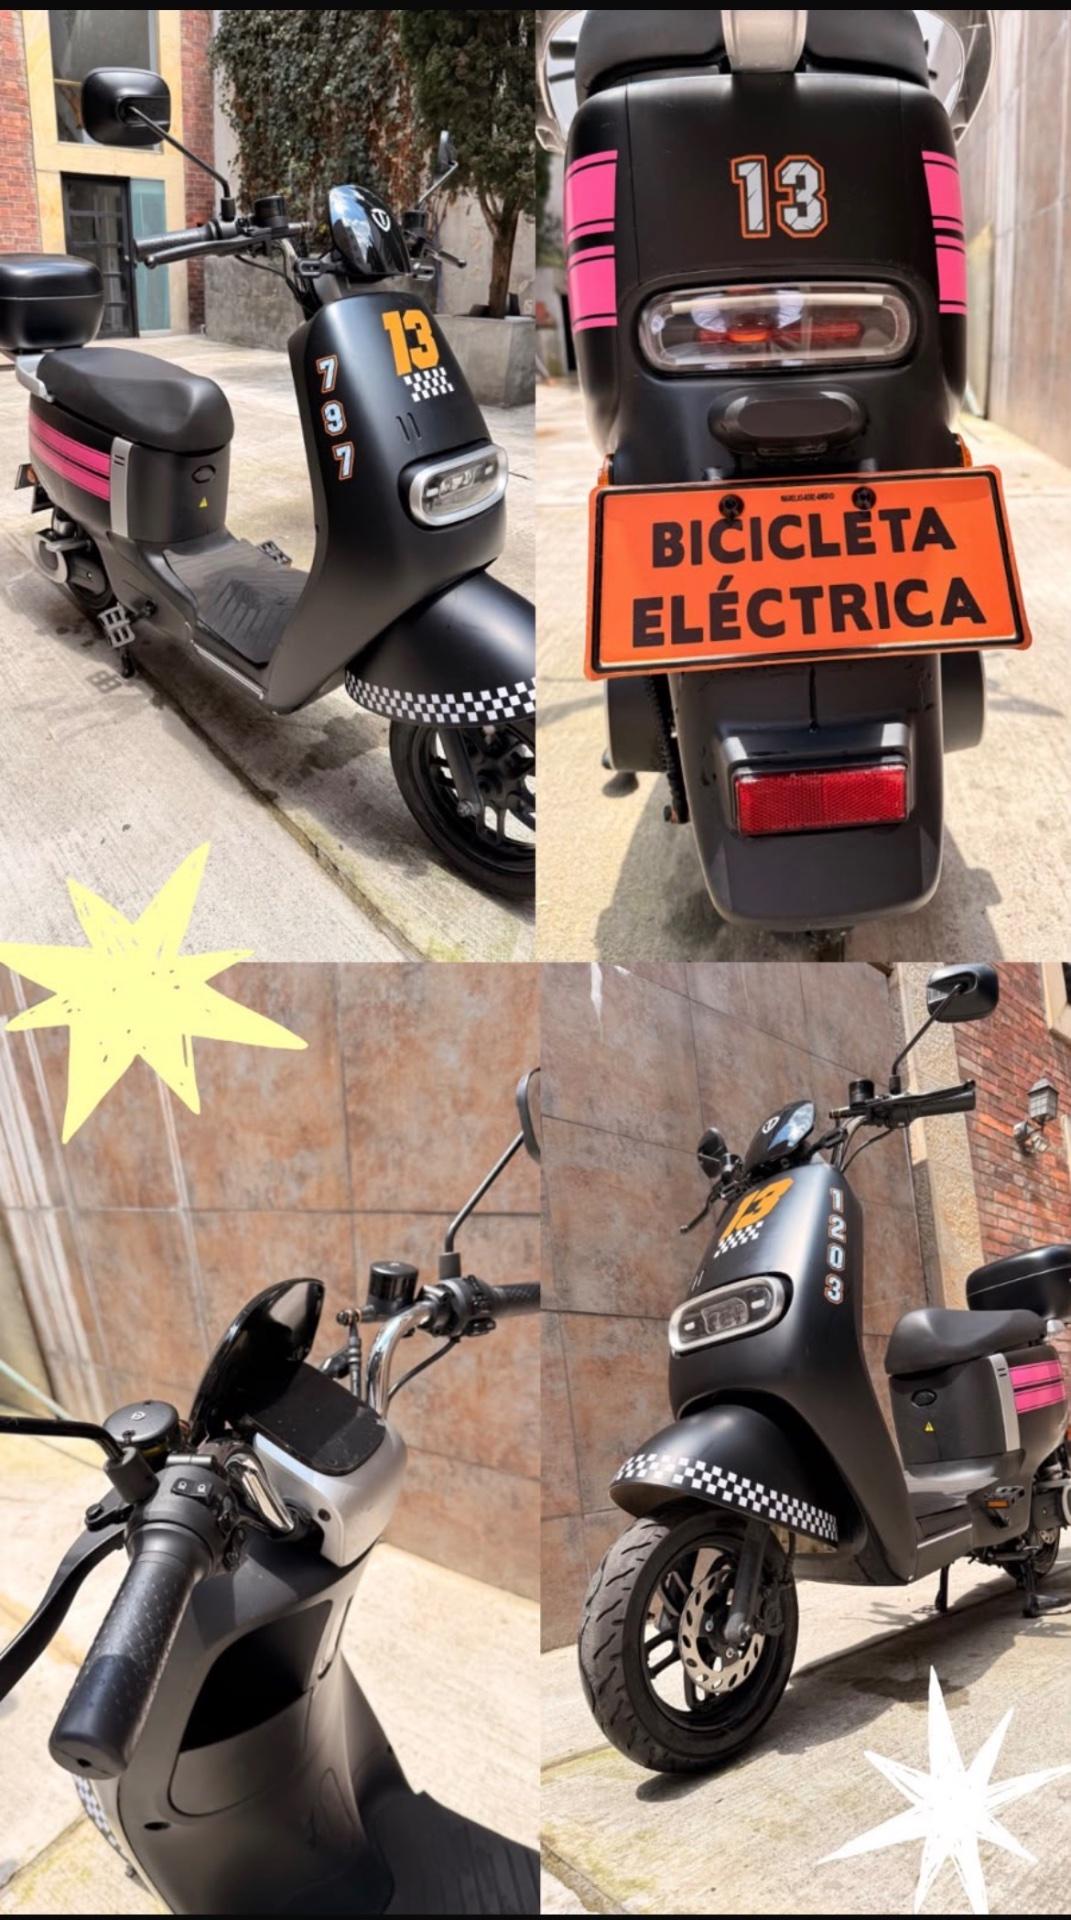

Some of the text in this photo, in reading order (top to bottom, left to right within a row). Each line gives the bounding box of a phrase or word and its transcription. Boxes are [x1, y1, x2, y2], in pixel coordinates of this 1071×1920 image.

[731, 154, 828, 238] 13
[382, 309, 440, 376] 13
[652, 506, 956, 568] BICICLETA
[633, 575, 986, 648] ELÉCTRICA
[720, 1177, 794, 1241] 13
[824, 1187, 847, 1305] 1203
